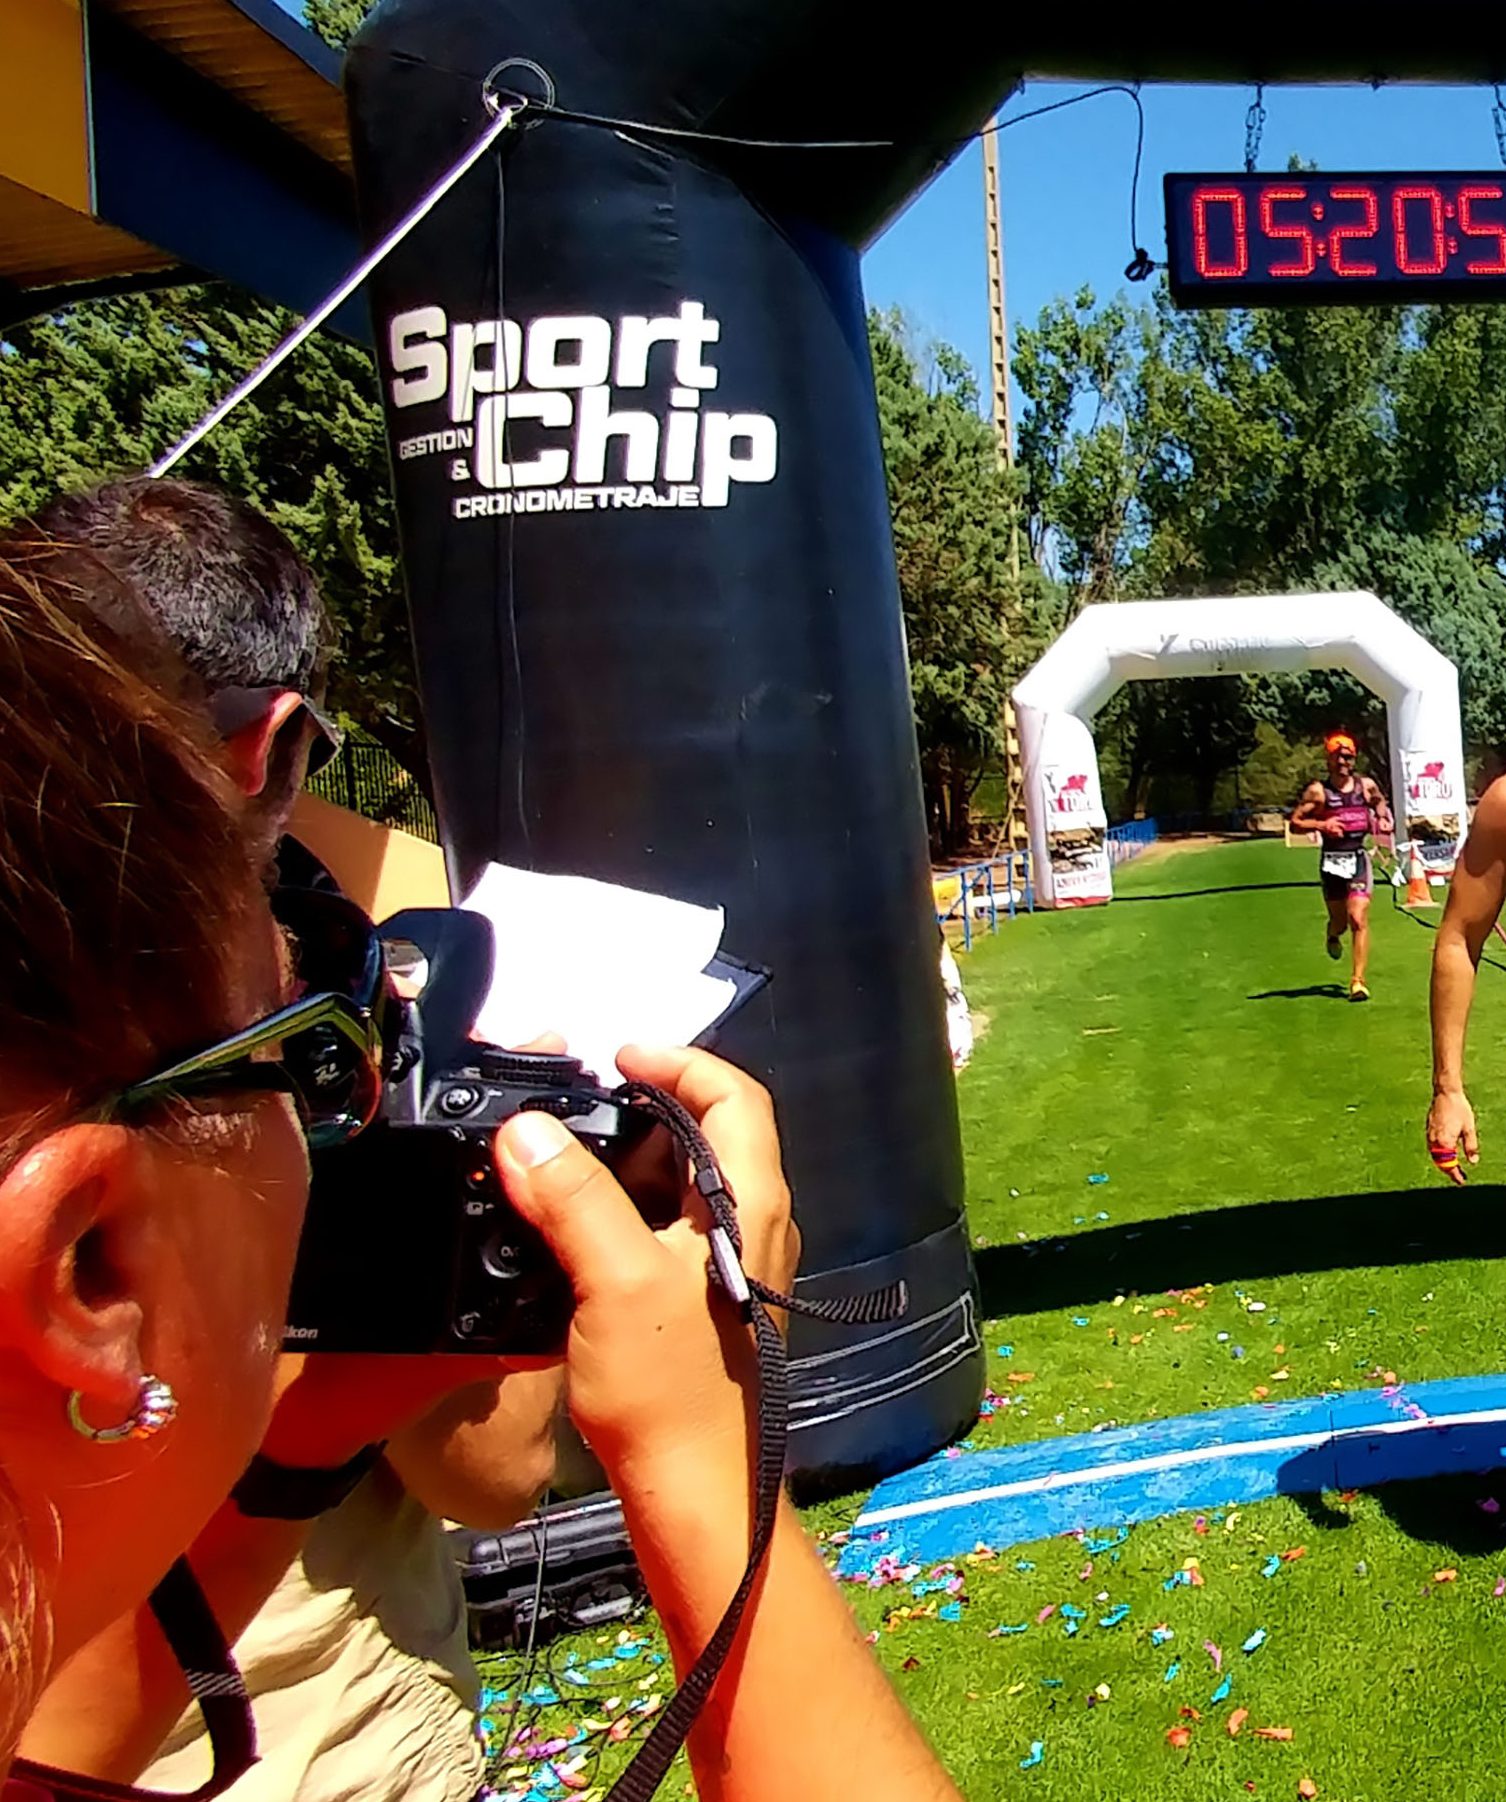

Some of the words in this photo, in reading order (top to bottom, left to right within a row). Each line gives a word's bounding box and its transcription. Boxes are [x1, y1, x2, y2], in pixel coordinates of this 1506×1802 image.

[389, 299, 720, 422] Sport
[398, 427, 474, 459] GESTION
[474, 385, 779, 508] Chip
[450, 458, 469, 481] &
[454, 484, 701, 519] CRONOMETRAJE
